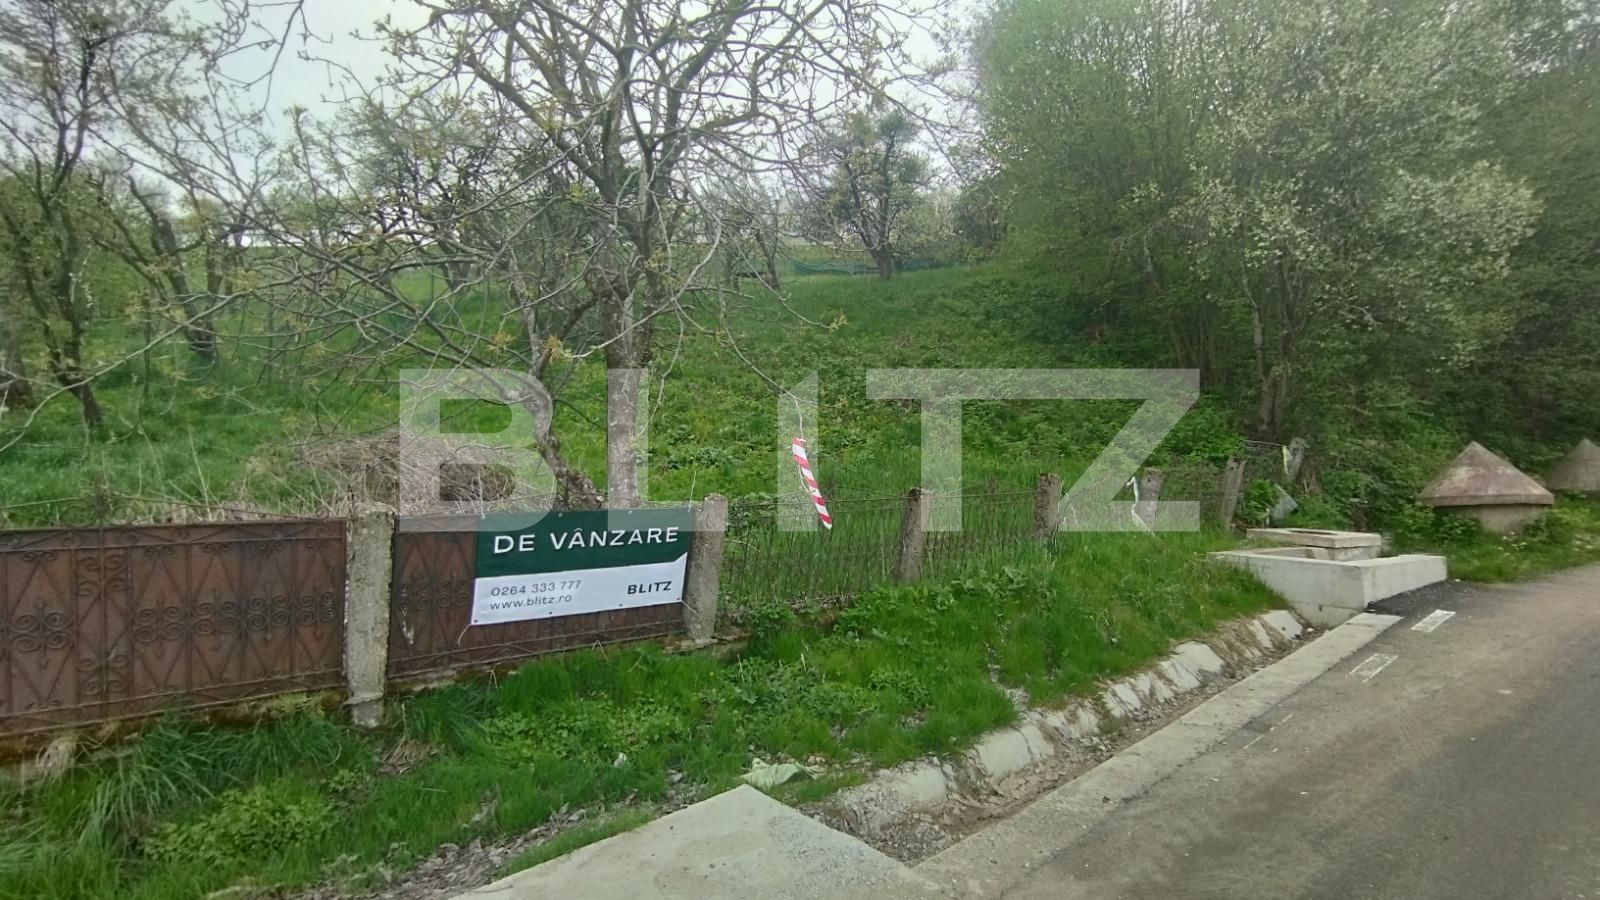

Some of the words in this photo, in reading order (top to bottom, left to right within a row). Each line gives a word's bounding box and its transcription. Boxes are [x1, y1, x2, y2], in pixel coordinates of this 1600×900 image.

[493, 534, 536, 554] DE
[549, 526, 680, 550] VÂNZARE
[491, 586, 526, 597] 0264
[531, 582, 556, 593] 333
[560, 579, 582, 590] 777
[626, 580, 673, 595] BLITZ
[490, 593, 573, 610] www.blitz.ro
